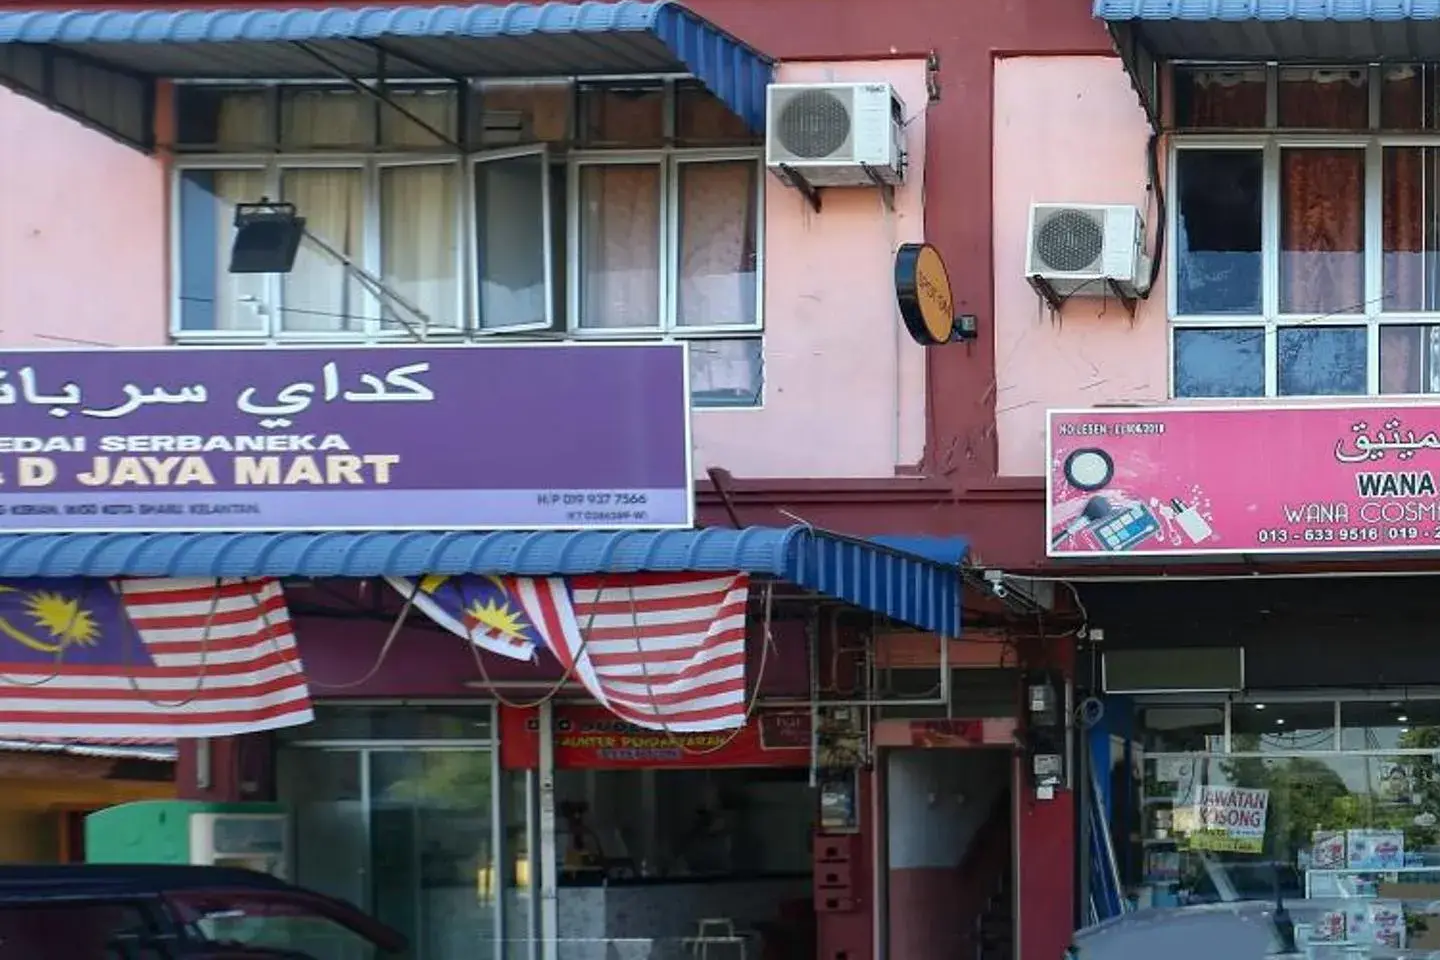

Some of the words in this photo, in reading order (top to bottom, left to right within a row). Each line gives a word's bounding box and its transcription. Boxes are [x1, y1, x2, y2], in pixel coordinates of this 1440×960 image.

[236, 360, 436, 429] كداي
[99, 432, 353, 453] SERBANEKA
[17, 455, 58, 488] D
[76, 455, 217, 488] JAYA
[233, 453, 401, 487] MART
[1357, 470, 1437, 497] WANA
[1280, 502, 1350, 524] WANA
[1258, 528, 1288, 542] 013
[1304, 528, 1334, 541] 633
[1388, 526, 1418, 540] 019
[1199, 786, 1266, 809] JAWATAN
